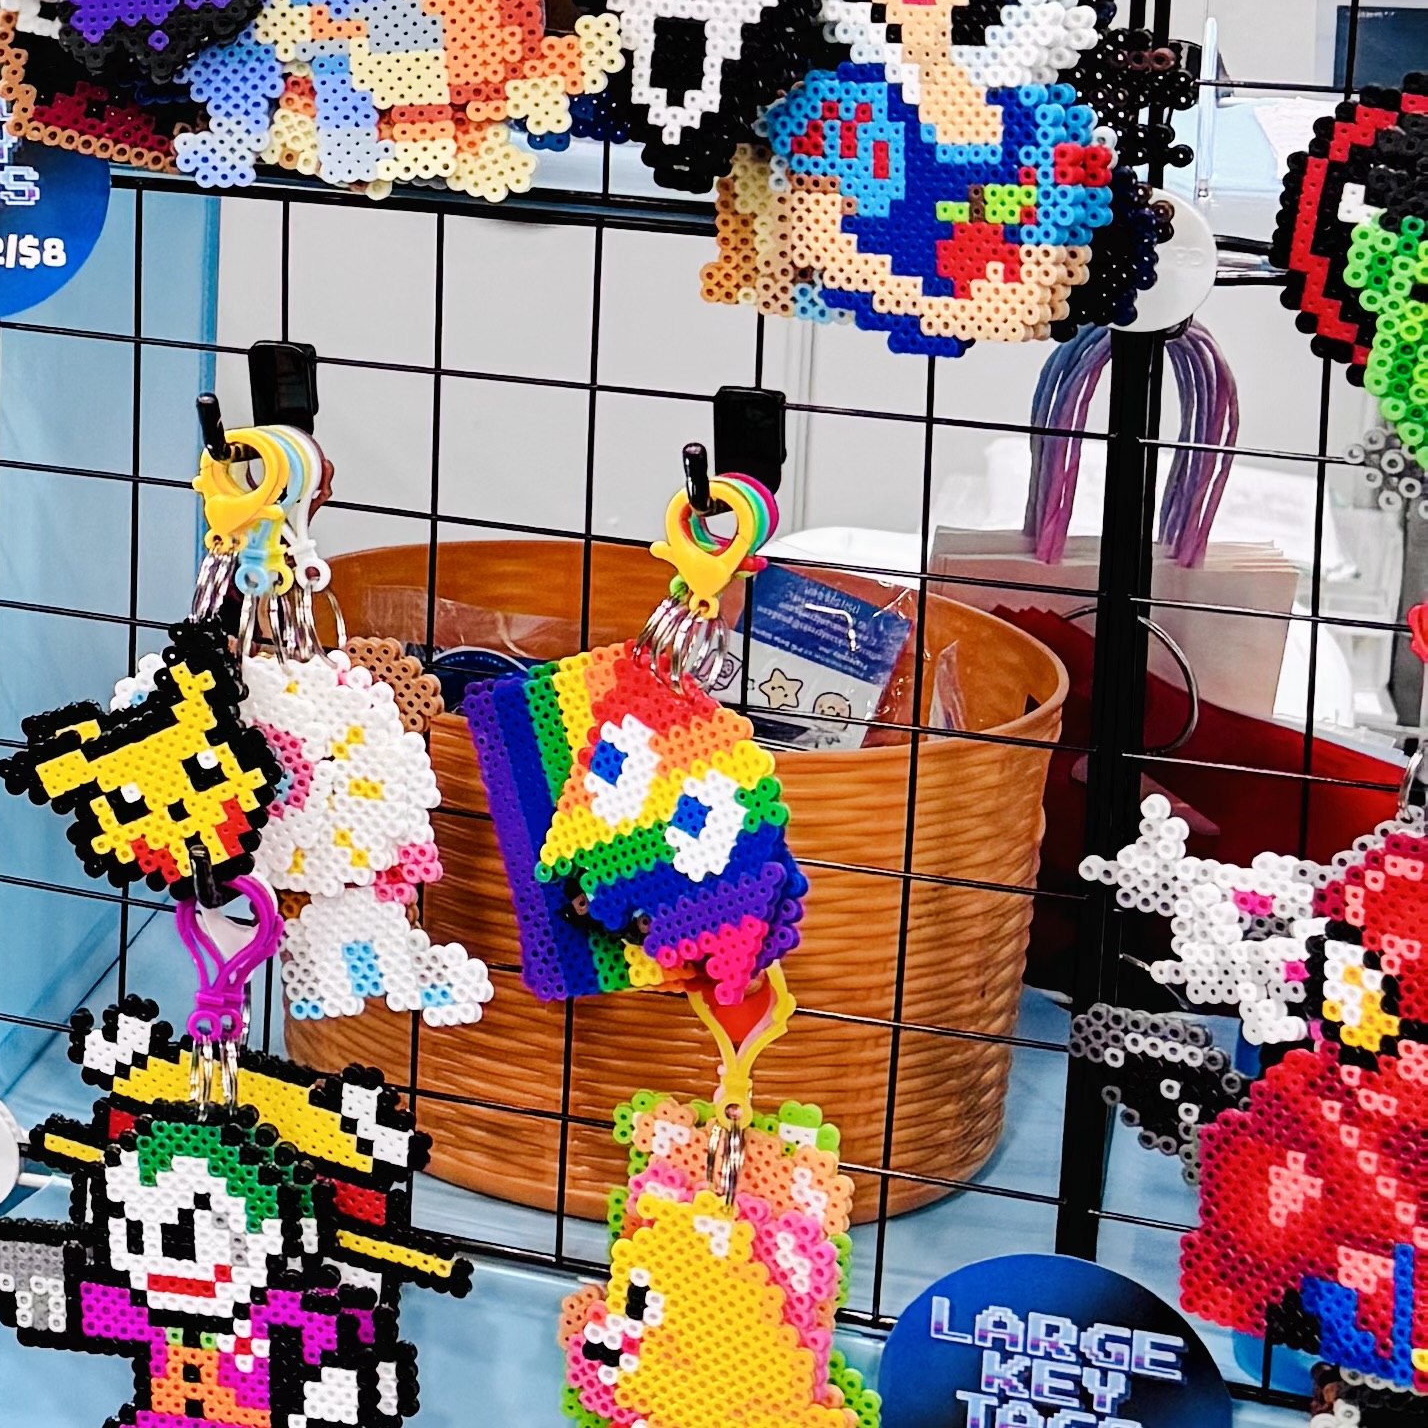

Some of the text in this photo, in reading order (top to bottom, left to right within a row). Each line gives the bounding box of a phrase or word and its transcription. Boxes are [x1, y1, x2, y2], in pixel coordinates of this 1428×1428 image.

[930, 1295, 1184, 1382] LARGE
[956, 1390, 1144, 1428] TA
[981, 1350, 1130, 1416] KEY
